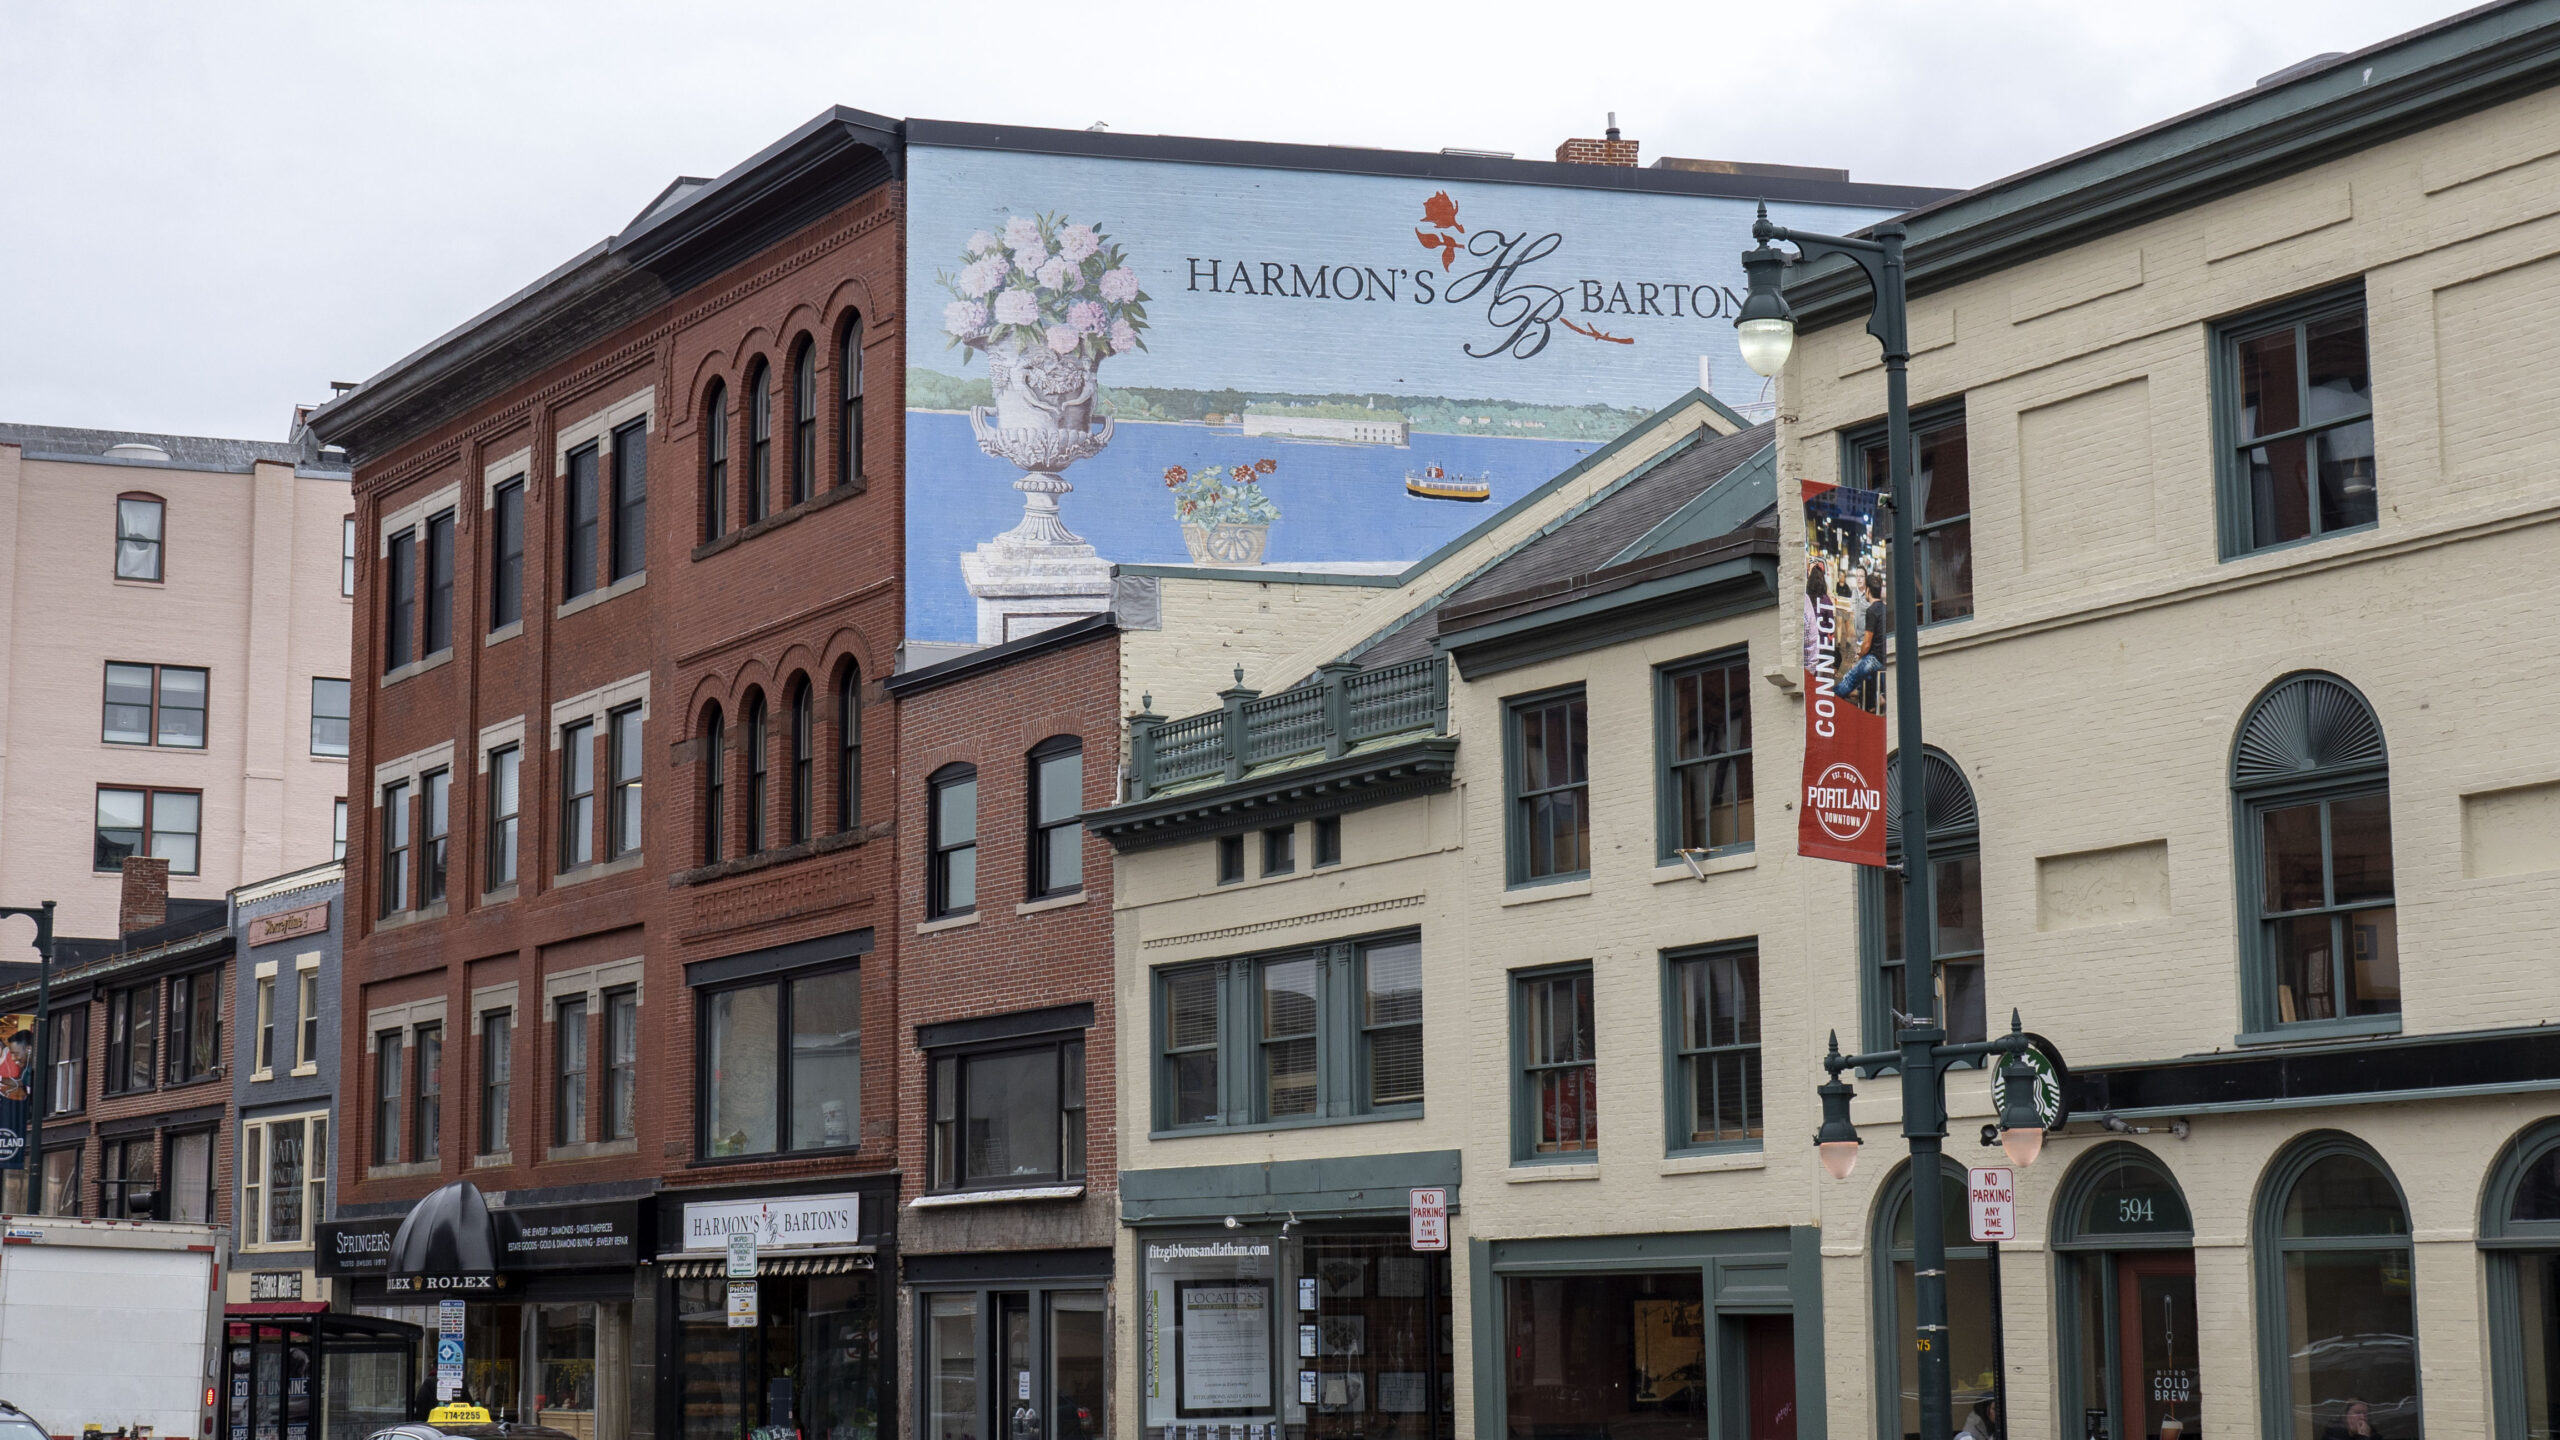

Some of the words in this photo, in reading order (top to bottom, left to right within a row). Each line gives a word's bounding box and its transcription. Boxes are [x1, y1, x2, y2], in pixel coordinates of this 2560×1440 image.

[1186, 257, 1435, 305] HARMON'S
[1579, 279, 1749, 319] BARTON
[1815, 597, 1836, 738] CONNECT
[1831, 771, 1842, 781] EST.
[1807, 786, 1880, 811] PORTLAND
[1824, 811, 1861, 828] DOWNTOWN
[1984, 1172, 1998, 1186] NO
[1421, 1193, 1435, 1205] NO
[1972, 1189, 2011, 1203] PARKING
[1413, 1207, 1444, 1218] PARKING
[1985, 1207, 2000, 1216] ANY
[2119, 1197, 2155, 1222] 594
[522, 1227, 532, 1237] FINE
[532, 1226, 548, 1236] JEWELRY
[551, 1224, 574, 1236] DIAMONDS
[576, 1224, 590, 1234] SWISS
[590, 1222, 613, 1233] TIMEPIECES
[693, 1214, 760, 1237] HARMON'S
[784, 1209, 849, 1233] BARTON'S
[1421, 1220, 1435, 1228] ANY
[1984, 1218, 2002, 1228] TIME
[1420, 1229, 1437, 1237] TIME
[336, 1230, 391, 1254] SPRINGER'S
[508, 1242, 521, 1252] ESTATE
[521, 1240, 538, 1250] GOODS
[539, 1240, 552, 1250] GOLD
[556, 1238, 577, 1249] DIAMOND
[577, 1237, 593, 1248] BUYING
[596, 1236, 614, 1247] JEWELRY
[614, 1235, 629, 1246] REPAIR
[1149, 1241, 1270, 1263] fitzgibbonsandlatham.com
[387, 1277, 411, 1290] OLEX
[426, 1275, 491, 1289] ROLEX
[729, 1286, 755, 1294] PHONE
[1187, 1291, 1264, 1304] LOCATIONS
[1146, 1289, 1154, 1398] LOCATIONS
[234, 1381, 248, 1397] GO
[2154, 1377, 2189, 1389] COLD
[2154, 1389, 2190, 1402] BREW
[443, 1411, 481, 1421] 774-2255
